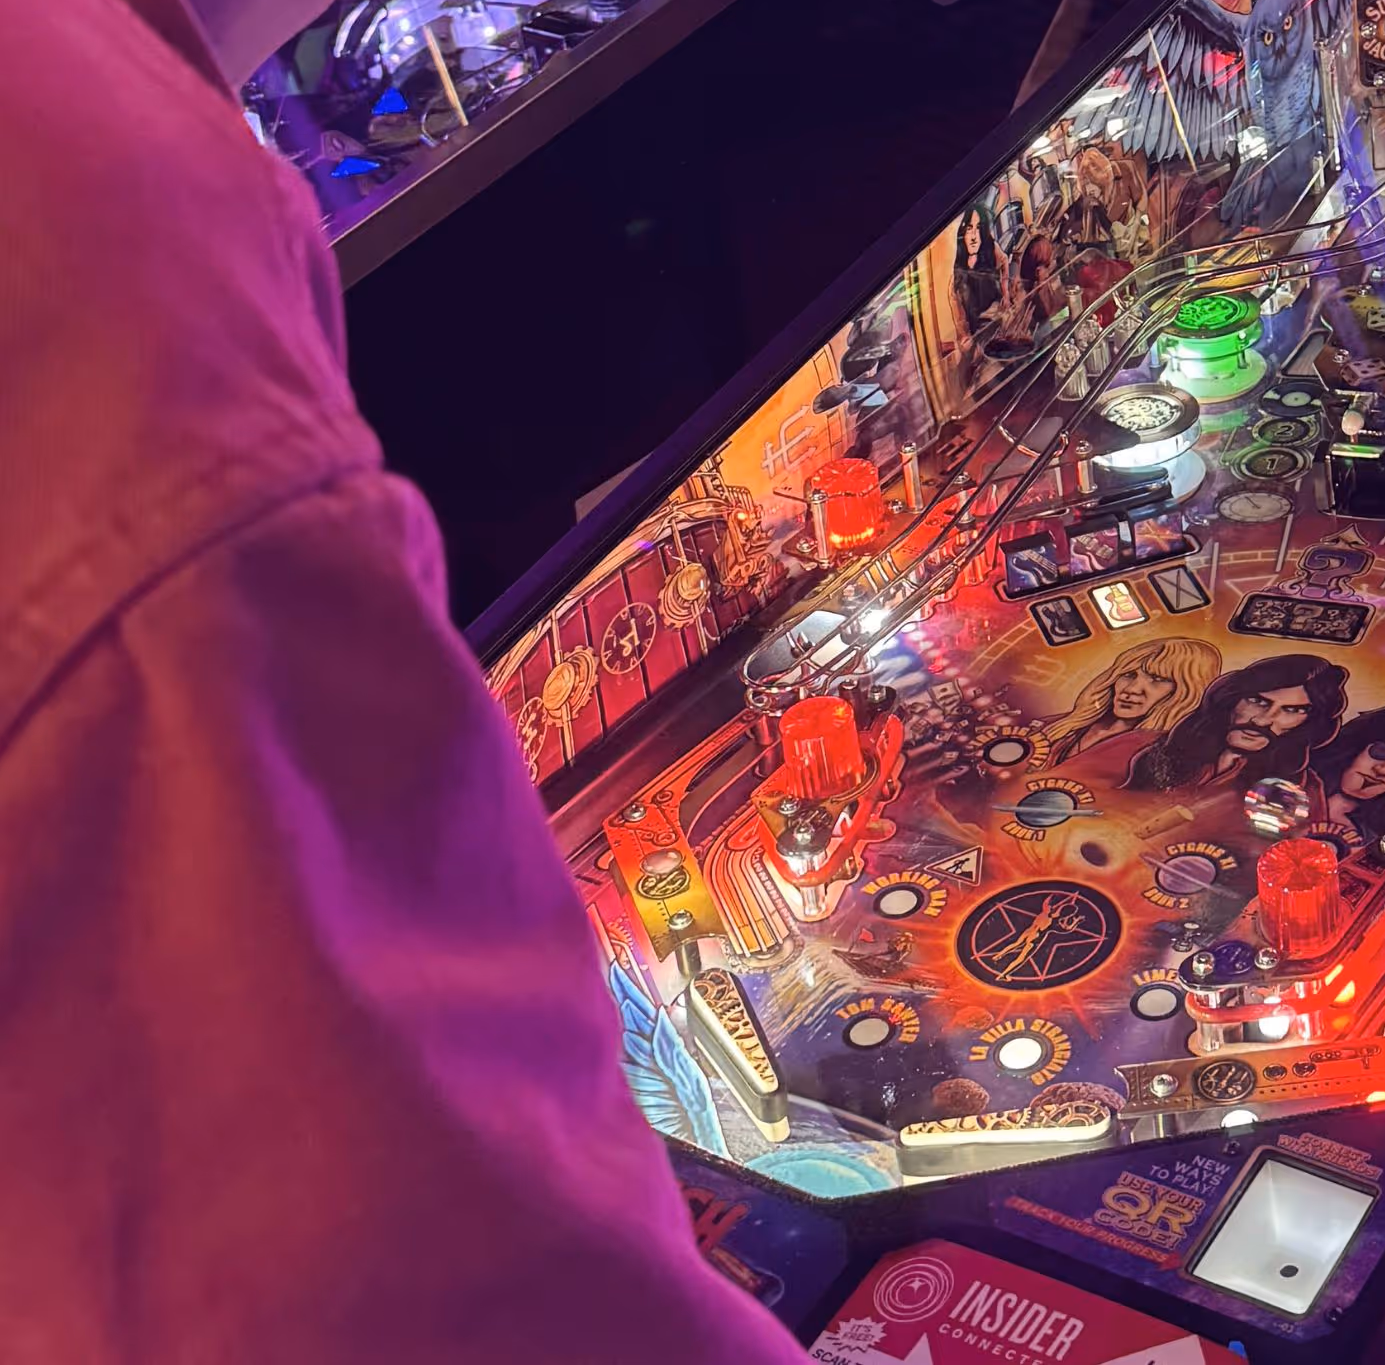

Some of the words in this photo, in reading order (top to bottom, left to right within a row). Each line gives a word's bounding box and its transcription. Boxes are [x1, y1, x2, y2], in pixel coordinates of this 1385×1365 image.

[1027, 778, 1084, 794] CYGNUS
[1166, 841, 1225, 863] CYGNUS
[861, 871, 941, 895] WORKING
[922, 889, 948, 917] MAN
[1143, 886, 1175, 908] BOOK
[835, 997, 875, 1019] TOM
[969, 1045, 990, 1061] LA
[980, 1018, 1026, 1044] VILLA
[1030, 1018, 1071, 1086] STRANGIATO
[1149, 1165, 1170, 1180] TO
[1171, 1174, 1216, 1196] PLAY!
[1174, 1161, 1223, 1186] WAYS
[1190, 1155, 1231, 1176] NEW
[1102, 1185, 1197, 1236] QR
[1119, 1172, 1151, 1195] USE
[1155, 1186, 1205, 1213] YOUR
[1055, 1213, 1093, 1235] YOUR
[1095, 1230, 1168, 1263] PROGRESS
[1094, 1208, 1182, 1250] CODE!
[949, 1280, 1085, 1362] INSIDER
